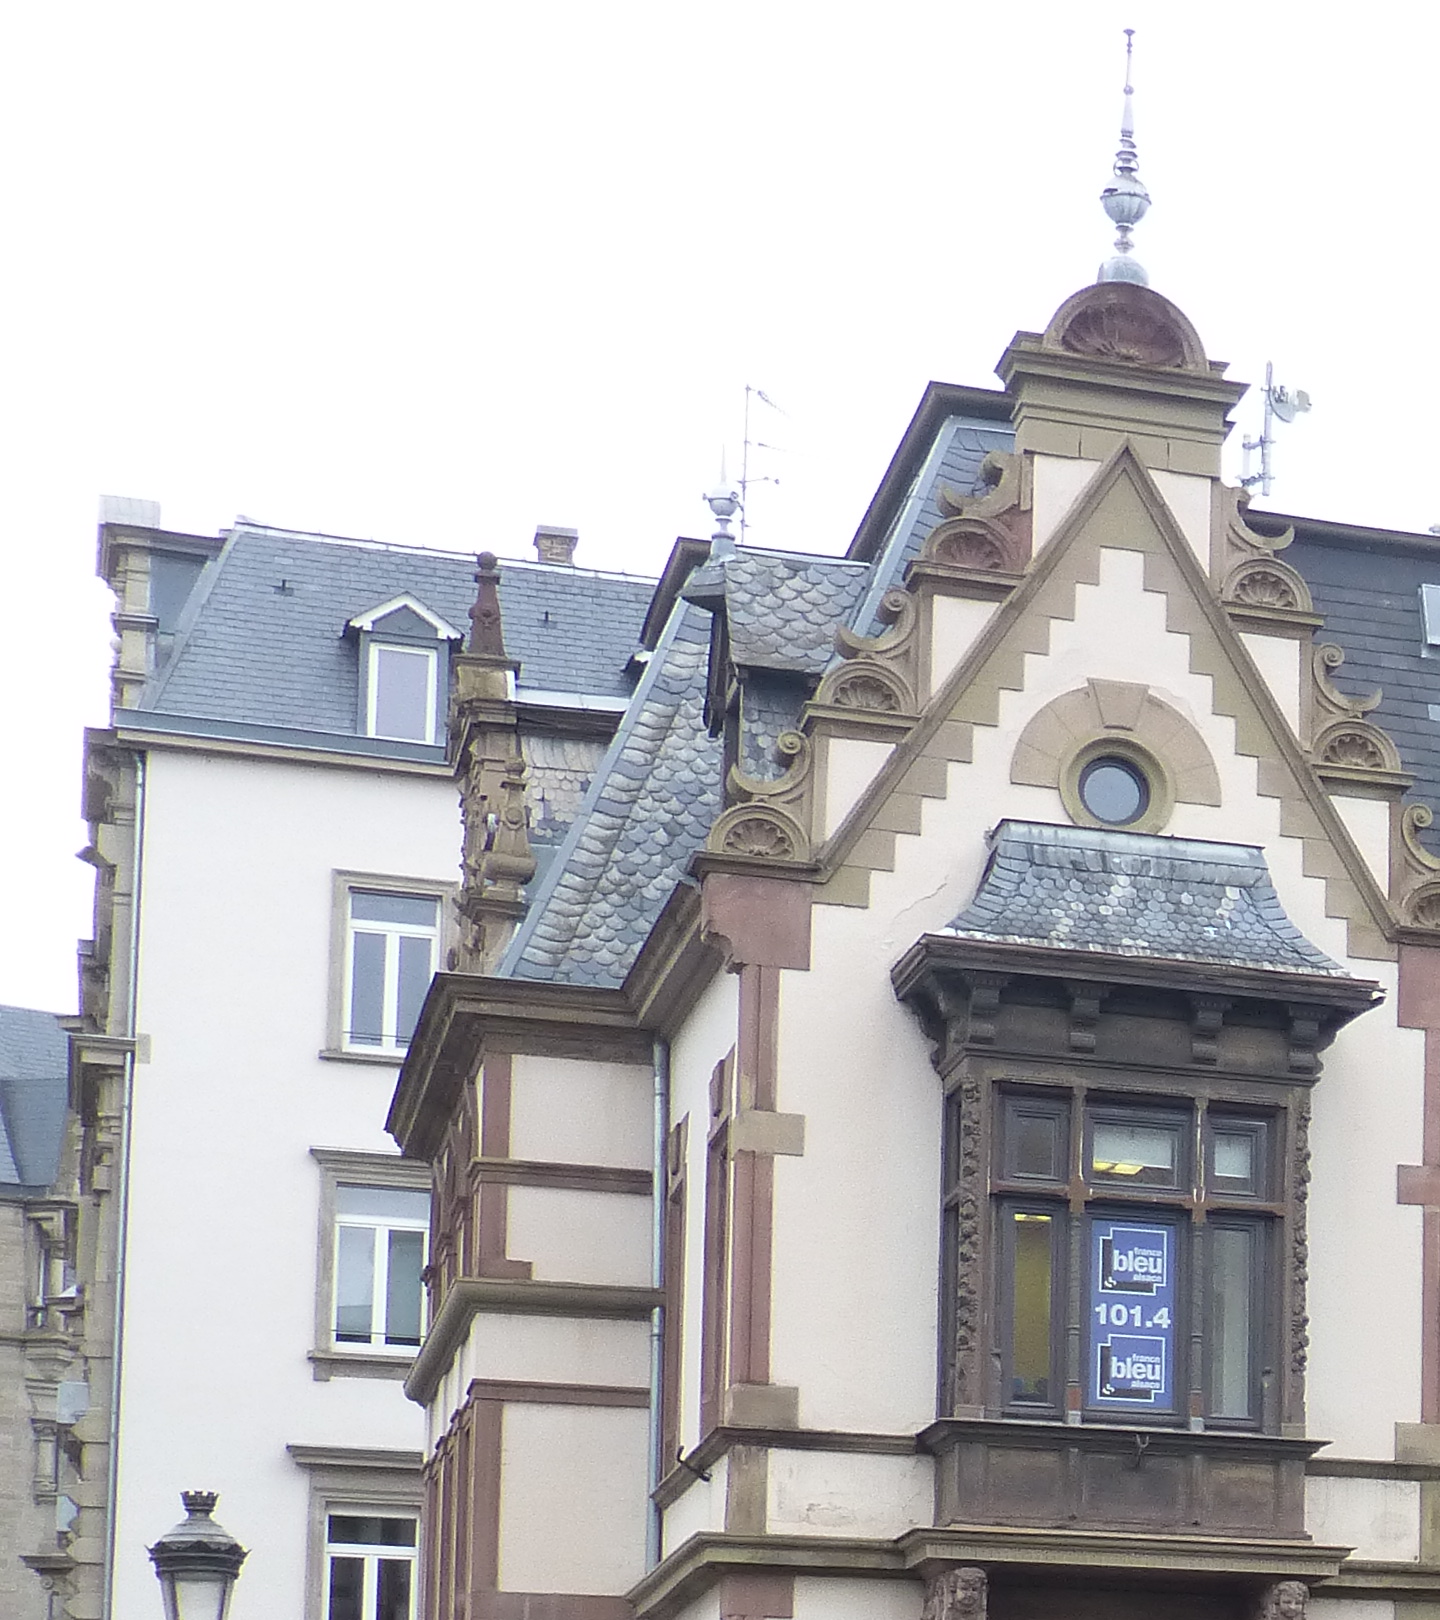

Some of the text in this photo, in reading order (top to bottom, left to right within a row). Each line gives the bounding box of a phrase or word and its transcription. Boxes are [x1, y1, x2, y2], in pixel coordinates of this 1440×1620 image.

[1113, 1249, 1163, 1274] bleu
[1095, 1303, 1171, 1329] 101.4
[1111, 1356, 1161, 1381] bleu
